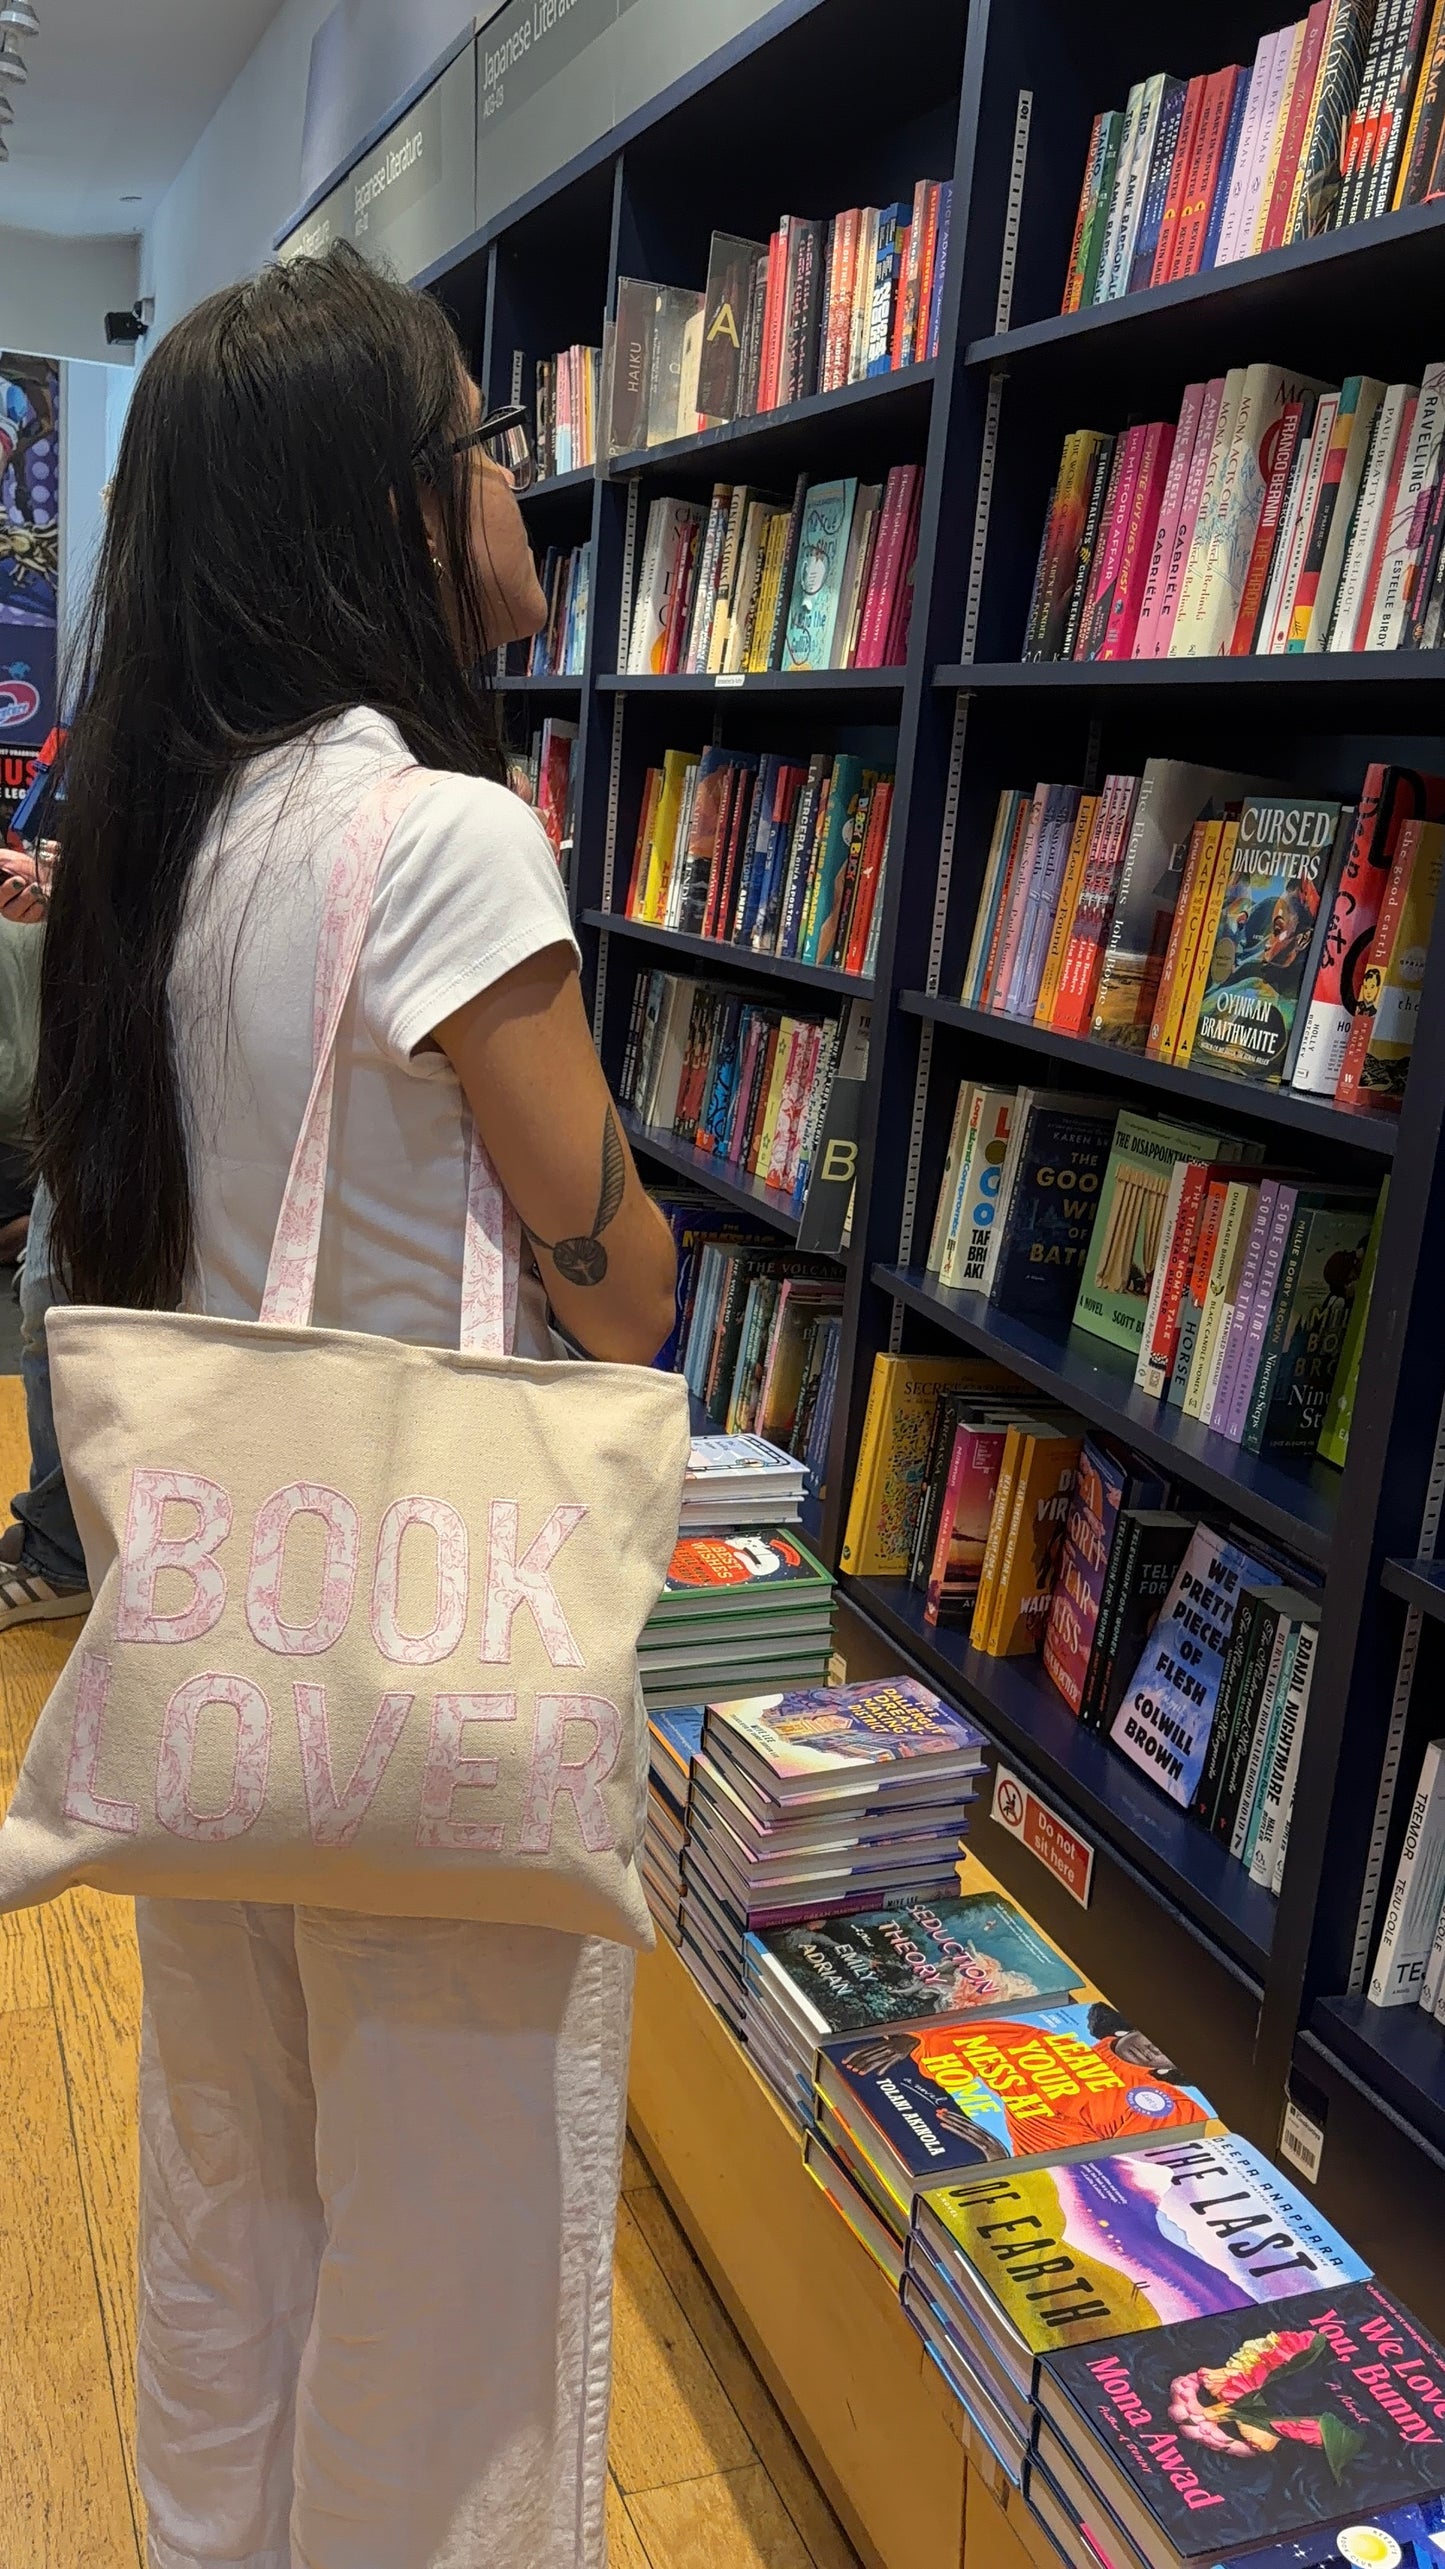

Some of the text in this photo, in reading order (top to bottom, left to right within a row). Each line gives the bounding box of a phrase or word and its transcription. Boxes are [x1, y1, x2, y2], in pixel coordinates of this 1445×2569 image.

[483, 20, 531, 90] Japanese
[1384, 45, 1405, 114] THE FLESH
[1355, 57, 1376, 124] THE FLESH
[1368, 51, 1390, 120] THE FLESH
[1240, 95, 1258, 168] BATUMAN
[1259, 90, 1278, 164] BATUMAN
[1386, 108, 1403, 161] AGUSTINA
[354, 131, 423, 216] Japanese Literature
[1122, 174, 1137, 213] AMIE
[1073, 157, 1094, 262] HOUSES COLIN
[938, 235, 949, 280] ADAMS
[706, 303, 740, 348] A
[627, 342, 642, 393] HAIKU
[1212, 400, 1231, 448] MONA
[1273, 414, 1298, 472] FRANCO
[1380, 406, 1395, 447] PAUL
[1408, 396, 1439, 493] RAVELLING
[1194, 396, 1250, 621] MONA Mischa Berlinski
[1261, 472, 1284, 528] BERNINI
[1366, 450, 1386, 510] BEATTY
[1105, 457, 1135, 580] MITFORD AFFAIR
[1277, 493, 1291, 527] ZERO
[1063, 459, 1107, 653] IMMORTALISTS CHLOE BENJAMIN
[1141, 527, 1166, 618] GABRIËLE
[1161, 524, 1187, 616] GABRIËLE
[1253, 537, 1272, 565] THE
[1242, 565, 1265, 617] THRONE
[1341, 547, 1362, 615] SELLOUT
[1384, 559, 1404, 609] ESTELLE
[1375, 612, 1392, 648] BIRDY
[796, 766, 817, 851] LA TERCERA
[1240, 807, 1331, 851] CURSED
[1051, 805, 1090, 956] Libby Lost Found
[1096, 777, 1155, 1006] The Elements John Boyne
[1232, 849, 1321, 880] DAUGHTERS
[807, 872, 822, 936] APPARENT
[1163, 835, 1200, 982] SEASONS JAPAN
[1179, 845, 1213, 979] CAT CITY
[1197, 846, 1231, 982] CAT CITY
[1374, 830, 1413, 959] the good earth
[1200, 1014, 1279, 1054] BRAITHWAITE
[1216, 991, 1272, 1023] OYINKAN
[1308, 1022, 1320, 1052] HOLLY
[821, 1139, 858, 1182] B
[950, 1096, 984, 1239] Long Island Compromise
[1052, 1133, 1092, 1145] KAREN
[1070, 1152, 1099, 1166] THE
[1115, 1131, 1130, 1149] THE
[1068, 1227, 1088, 1239] OF
[1204, 1192, 1221, 1251] GERALDINE
[1216, 1192, 1239, 1280] DIANE MARIE BROWN
[747, 1260, 776, 1274] THE
[1163, 1184, 1201, 1340] THE TIGER MOM'S TALE
[1233, 1194, 1272, 1332] SOME OTHER TIME
[1250, 1203, 1290, 1341] SOME OTHER TIME
[724, 1277, 736, 1323] VOLCANO
[1085, 1297, 1103, 1317] NOVEL
[1112, 1310, 1135, 1328] SCOTT
[1252, 1220, 1305, 1429] MILLIE BOBBY BROWN Nineteen Steps
[1174, 1320, 1197, 1389] HORSE
[951, 1445, 964, 1486] Milkman
[114, 1467, 590, 1669] BOOK
[690, 1541, 734, 1580] WISHES
[709, 1542, 744, 1571] BEST
[1207, 1558, 1239, 1594] WE
[1139, 1580, 1168, 1595] FOR
[1179, 1571, 1234, 1623] PRETT
[1096, 1608, 1111, 1648] WOMEN
[1179, 1639, 1204, 1668] OF
[1155, 1651, 1208, 1707] FLESH
[847, 1704, 890, 1734] DISTRICT
[858, 1696, 909, 1735] MAKING
[872, 1694, 925, 1736] DREAM-
[881, 1687, 946, 1735] DALLERGUT
[915, 1699, 940, 1718] THE
[1133, 1691, 1194, 1757] COLWILL
[1266, 1635, 1314, 1806] BANAL NIGHTMARE
[62, 1650, 624, 1854] LOVER
[764, 1733, 776, 1744] LEE
[1124, 1716, 1184, 1782] BROWN
[1038, 1811, 1076, 1861] Do not
[1257, 1809, 1269, 1841] BUTLER
[1263, 1816, 1275, 1844] HALLE
[1034, 1834, 1075, 1884] sit here
[1382, 1791, 1429, 1947] TREMOR TEJU COLE
[798, 1943, 854, 1996] ADRIAN
[834, 1942, 878, 1984] EMILY
[879, 1920, 948, 1986] THEORY
[907, 1904, 1000, 1994] SEDUCTION
[921, 2056, 1004, 2118] HOME
[952, 2034, 1026, 2095] MESS
[1003, 2092, 1056, 2120] AT
[1006, 2040, 1081, 2102] YOUR
[1042, 2031, 1125, 2094] LEAVE
[875, 2077, 946, 2157] TOLANI AKINOLA
[948, 2178, 1017, 2210] OF
[1144, 2141, 1223, 2191] THE
[1188, 2189, 1321, 2279] LAST
[1212, 2137, 1345, 2267] DEEPA ANAPPARA
[976, 2213, 1112, 2329] EARTH
[1308, 2308, 1360, 2363] You,
[1351, 2362, 1444, 2445] Bunny
[1358, 2316, 1404, 2358] We
[1391, 2358, 1445, 2420] Love
[1086, 2355, 1227, 2511] Mona Awad
[1340, 2395, 1371, 2424] Novel
